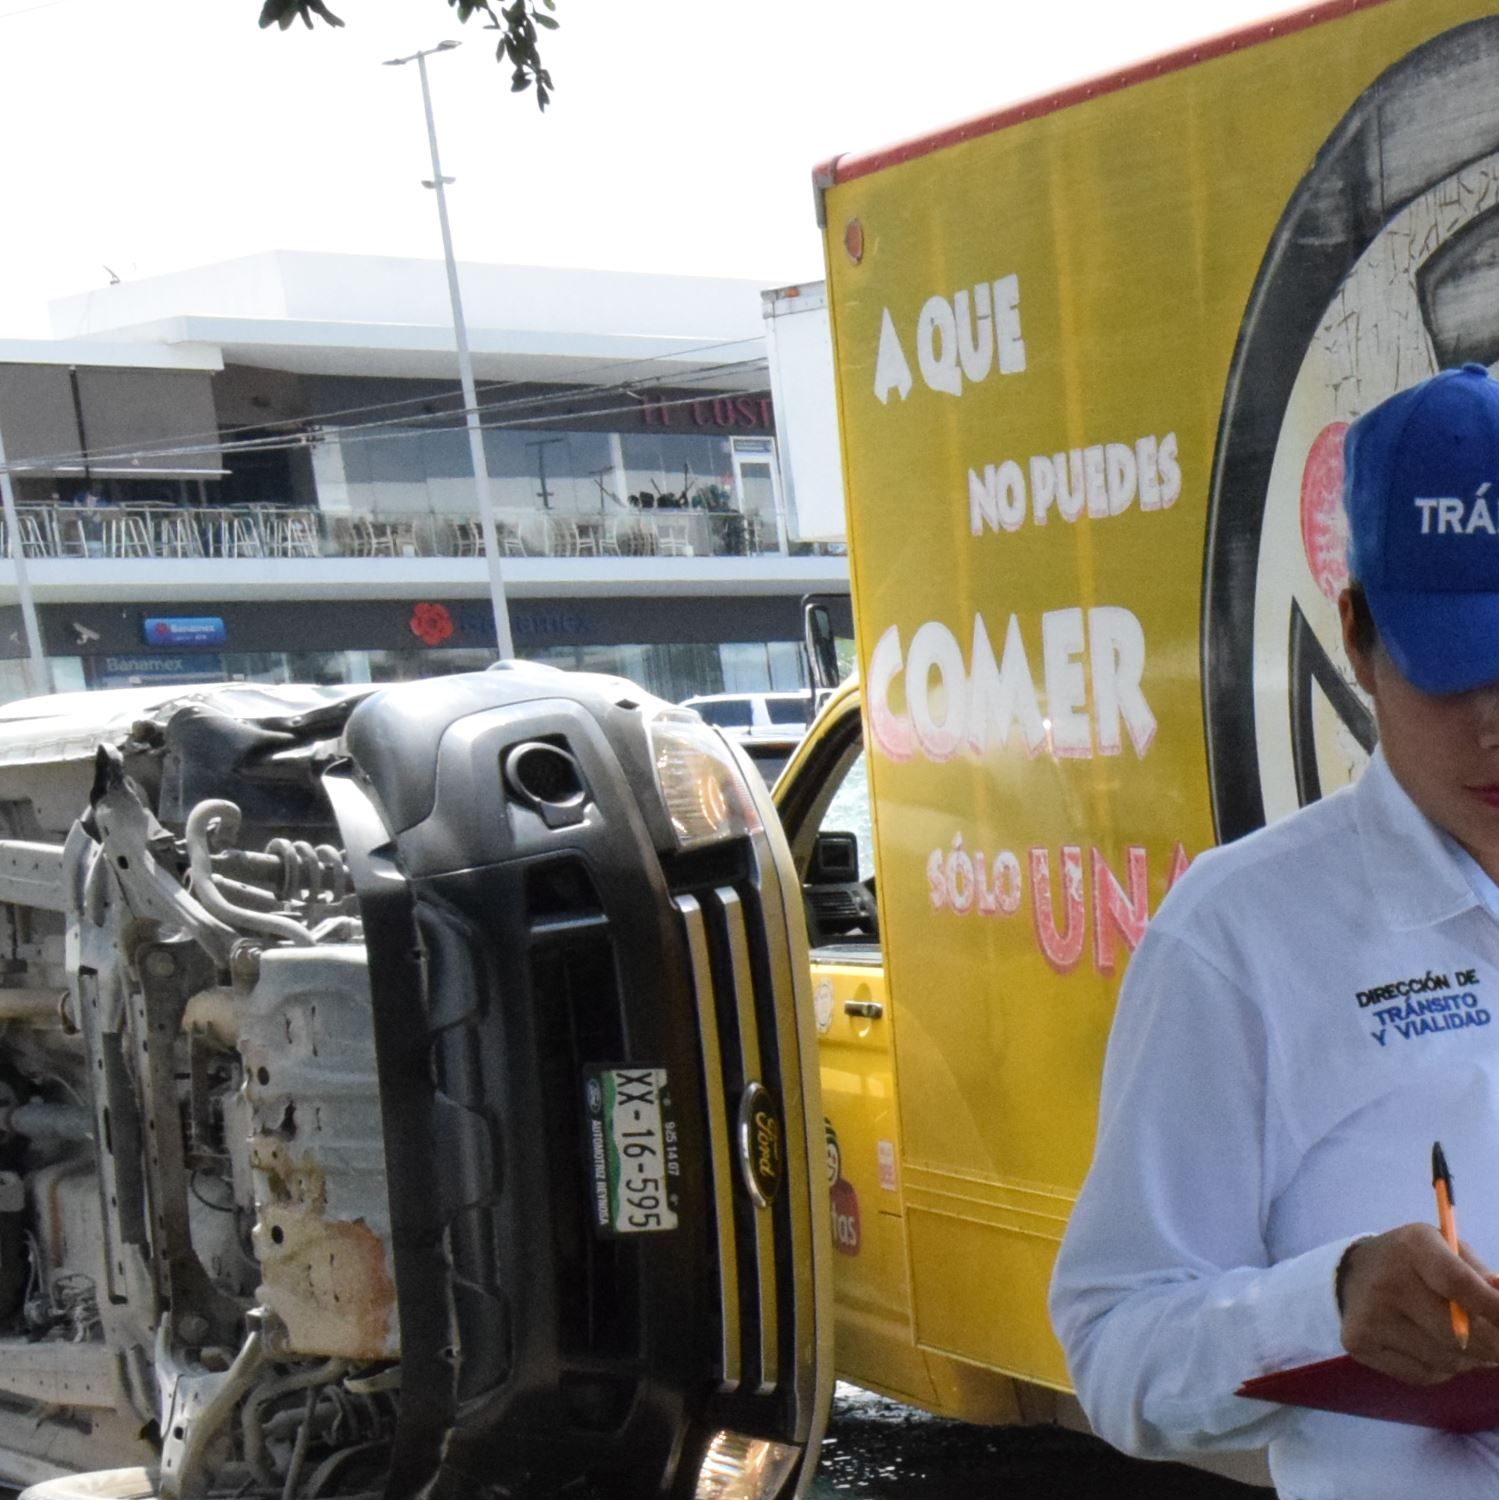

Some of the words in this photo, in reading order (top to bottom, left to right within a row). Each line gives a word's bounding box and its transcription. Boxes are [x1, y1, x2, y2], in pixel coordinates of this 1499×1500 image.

[873, 307, 913, 406] A
[916, 274, 1028, 398] QUE
[968, 466, 1027, 537] NO
[1030, 432, 1184, 528] PUEDES
[106, 657, 182, 672] Banamex
[868, 606, 1158, 764] COMER
[927, 831, 1022, 919] SÓLO
[1028, 839, 1190, 977] UN
[1355, 970, 1451, 1008] DIRECCIÓN
[1454, 968, 1480, 987] DE
[1371, 1028, 1386, 1047] Y
[1394, 1009, 1491, 1040] VIALIDAD
[1372, 992, 1478, 1026] TRÁNSITO
[615, 1071, 662, 1228] XX-16-595
[755, 1111, 776, 1177] Ford
